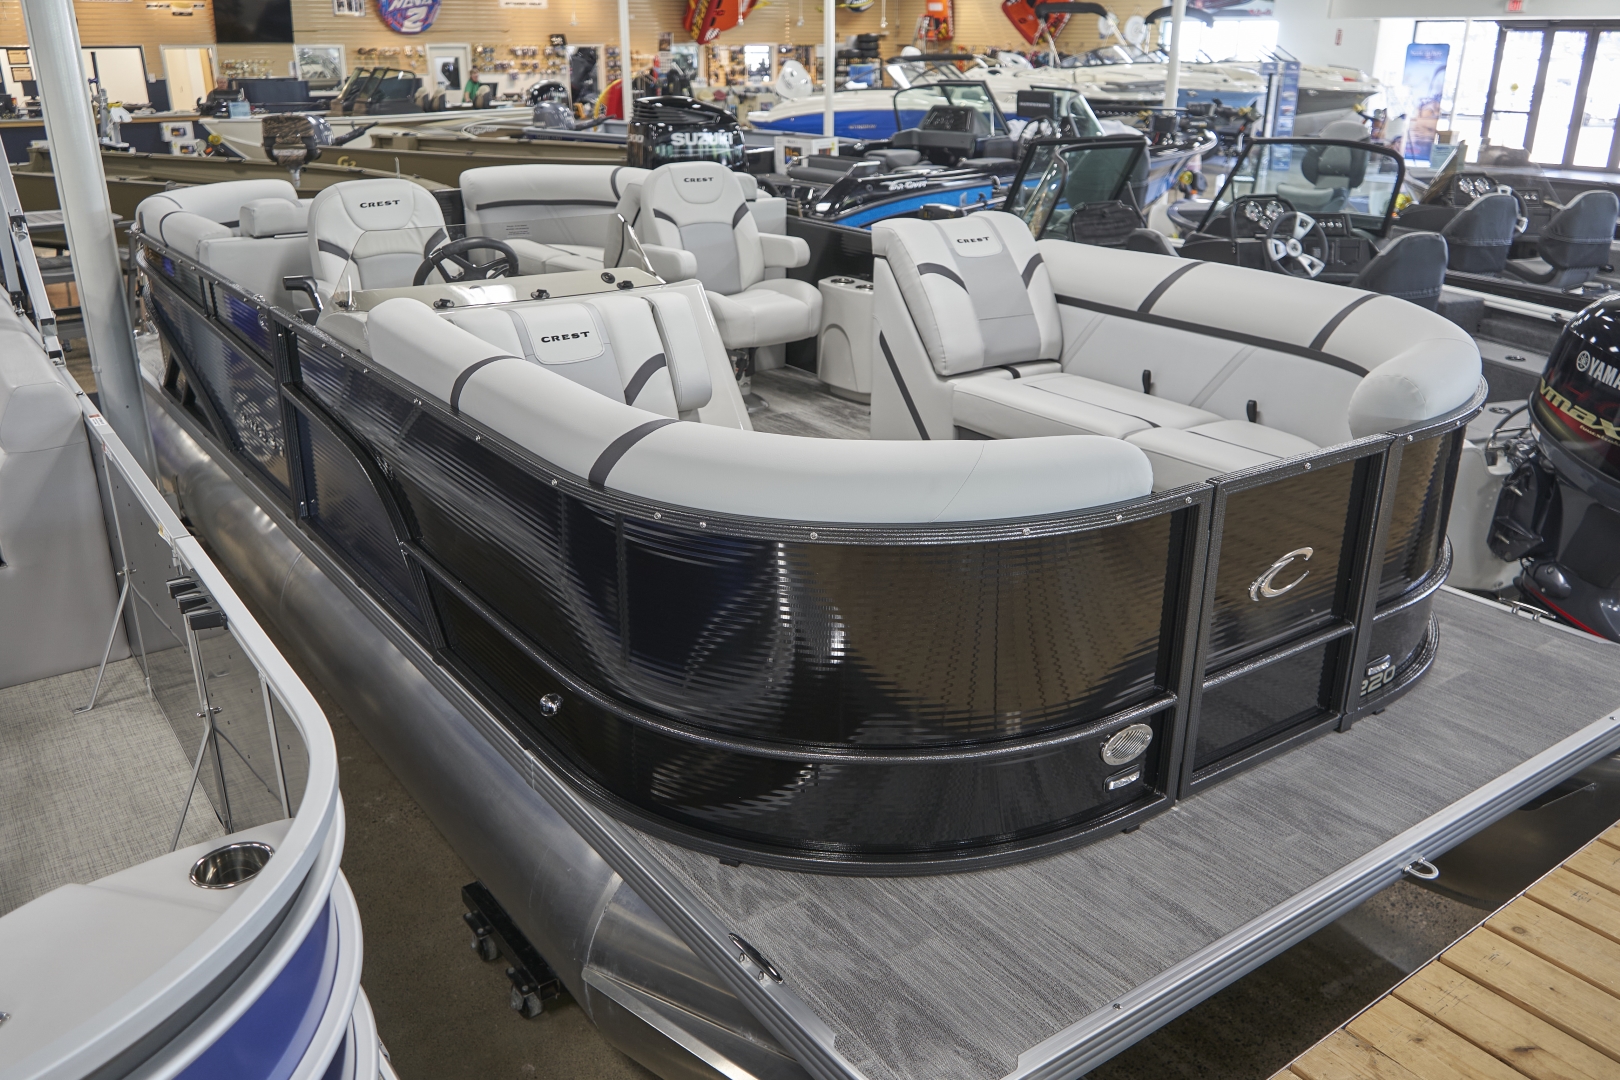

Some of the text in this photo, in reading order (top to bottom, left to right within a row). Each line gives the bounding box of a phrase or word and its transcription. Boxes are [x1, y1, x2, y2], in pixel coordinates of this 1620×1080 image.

[401, 6, 428, 32] 2
[670, 131, 734, 147] SUZUKI
[359, 199, 401, 209] CREST
[956, 236, 990, 244] CREST
[540, 330, 590, 343] CREST
[1360, 664, 1396, 697] 220
